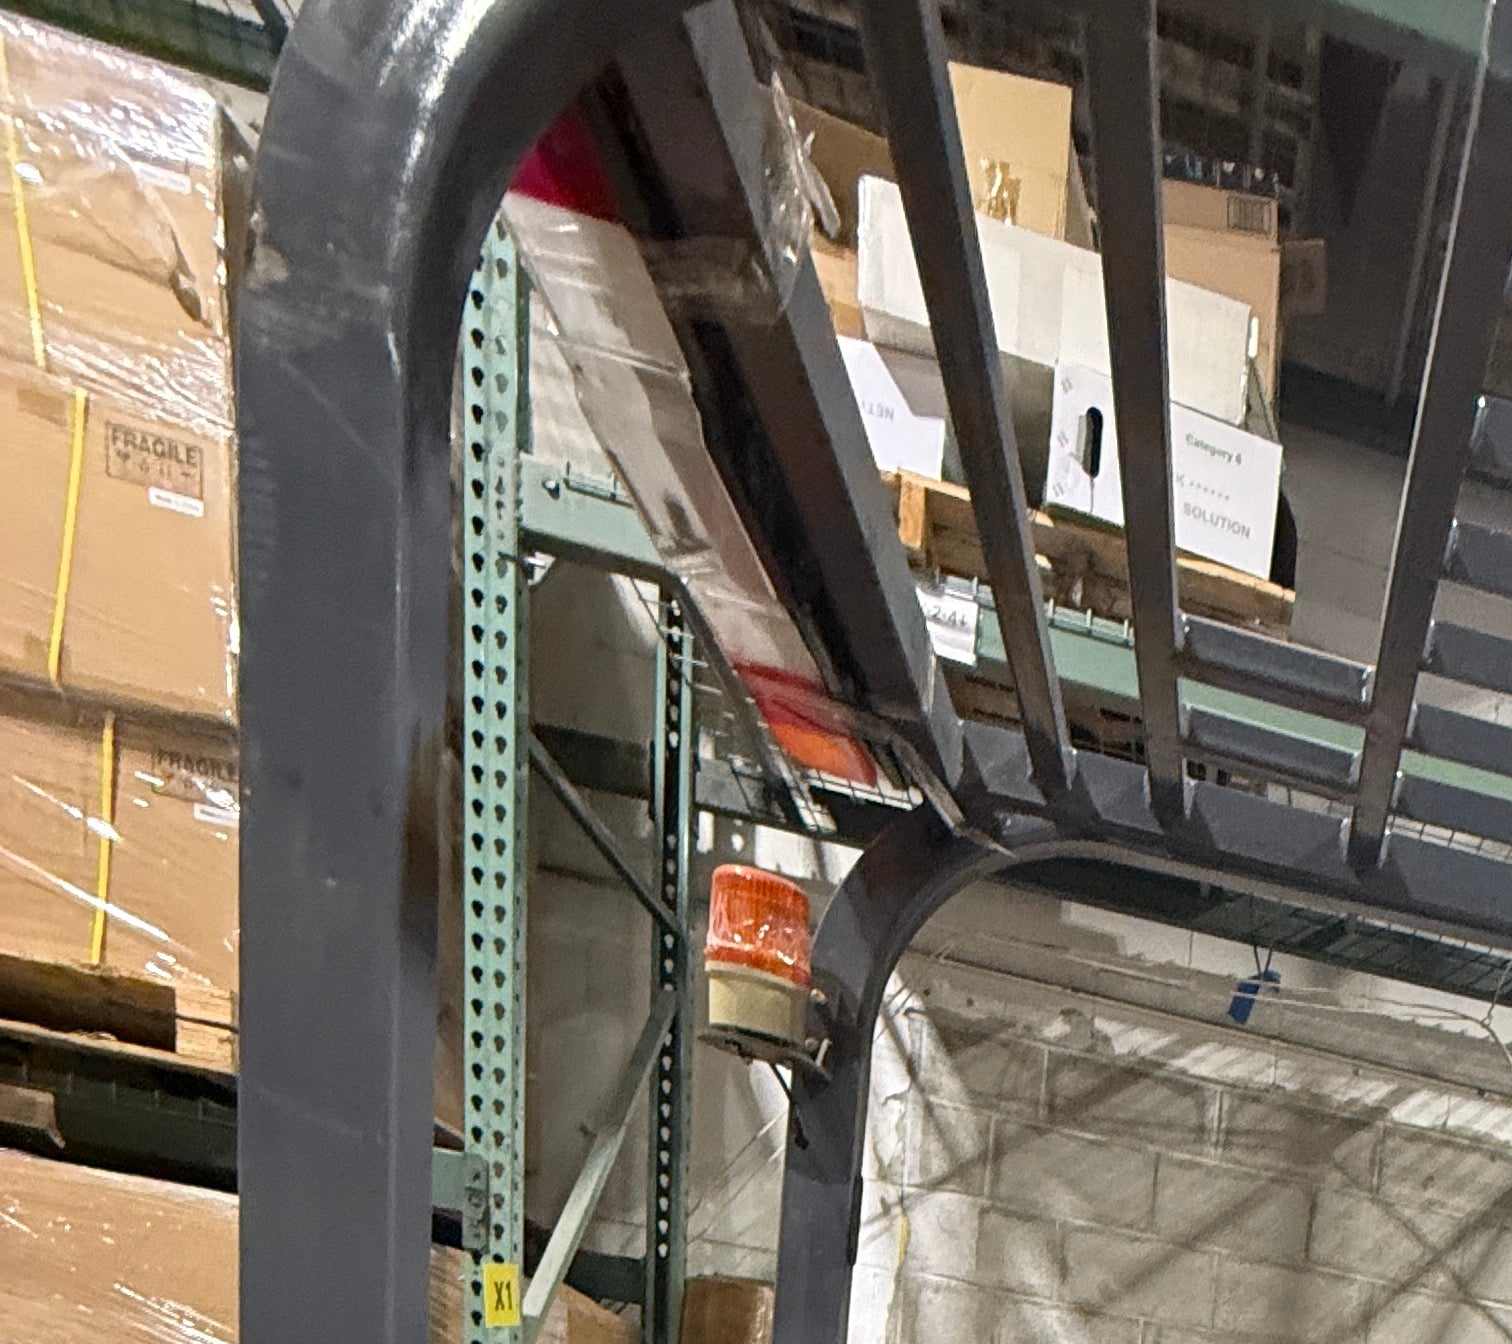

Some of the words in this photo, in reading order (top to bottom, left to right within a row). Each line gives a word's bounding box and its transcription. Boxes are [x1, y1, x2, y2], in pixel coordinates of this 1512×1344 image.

[111, 425, 198, 468] FRAGILE
[1185, 433, 1234, 463] Category
[1183, 502, 1251, 538] SOLUTION
[494, 1280, 513, 1312] X1
